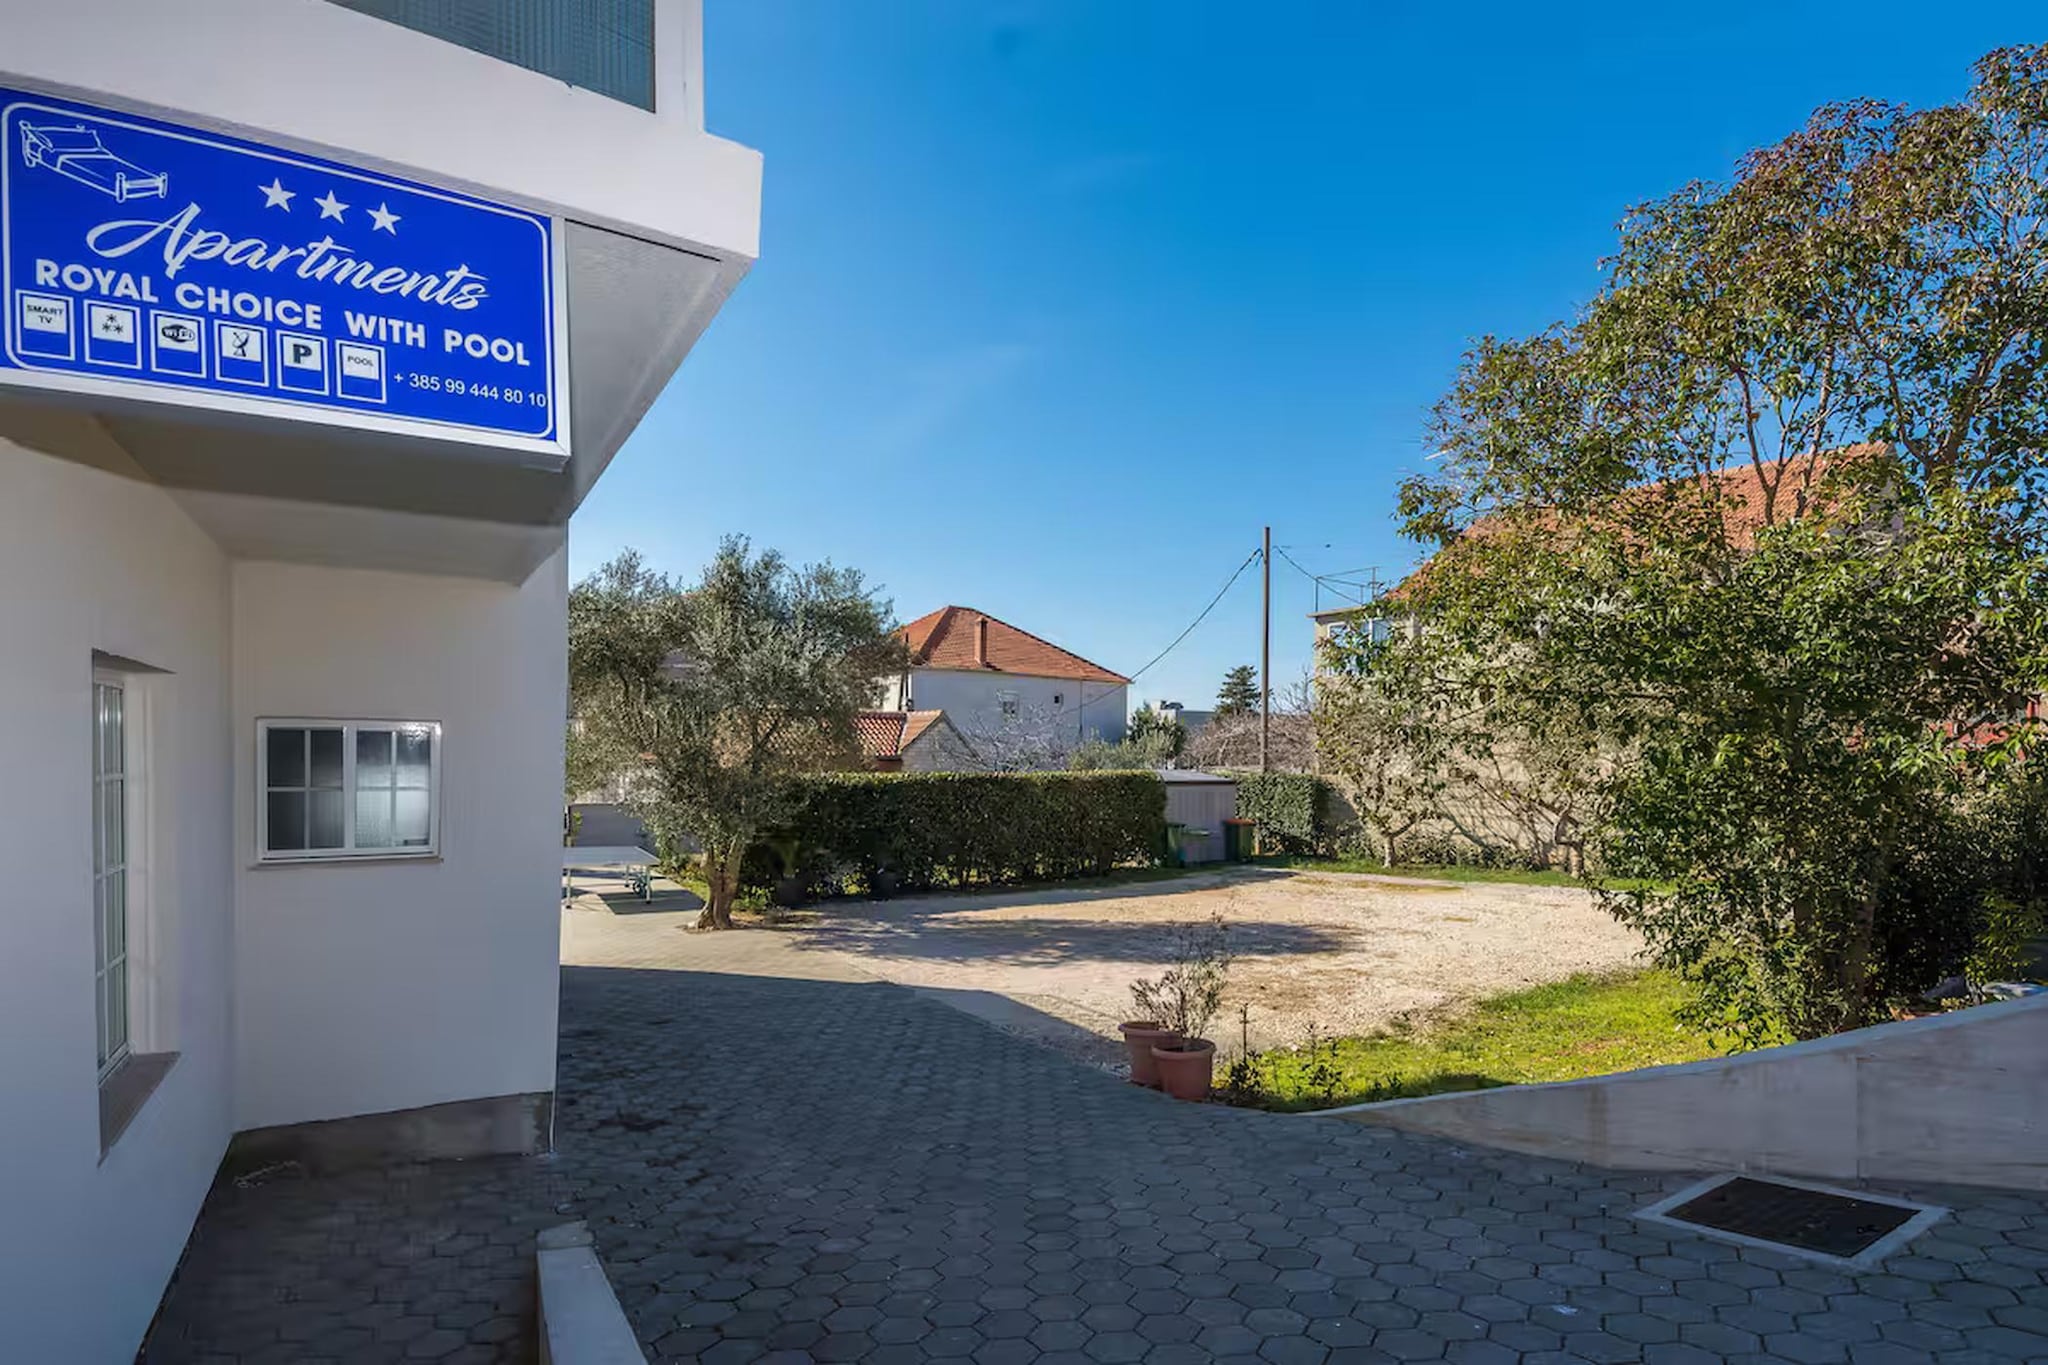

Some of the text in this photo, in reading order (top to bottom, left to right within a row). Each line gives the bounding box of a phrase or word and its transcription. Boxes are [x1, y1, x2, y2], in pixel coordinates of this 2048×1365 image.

[87, 203, 488, 310] Apartments
[27, 304, 64, 317] SMART
[36, 259, 530, 366] ROYAL CHOICE WITH POOL
[38, 315, 53, 325] TV
[292, 343, 312, 364] P
[347, 355, 374, 368] POOL
[409, 373, 441, 391] 385
[445, 379, 466, 395] 99
[470, 385, 500, 400] 444
[503, 388, 523, 404] 80
[528, 392, 547, 408] 10
